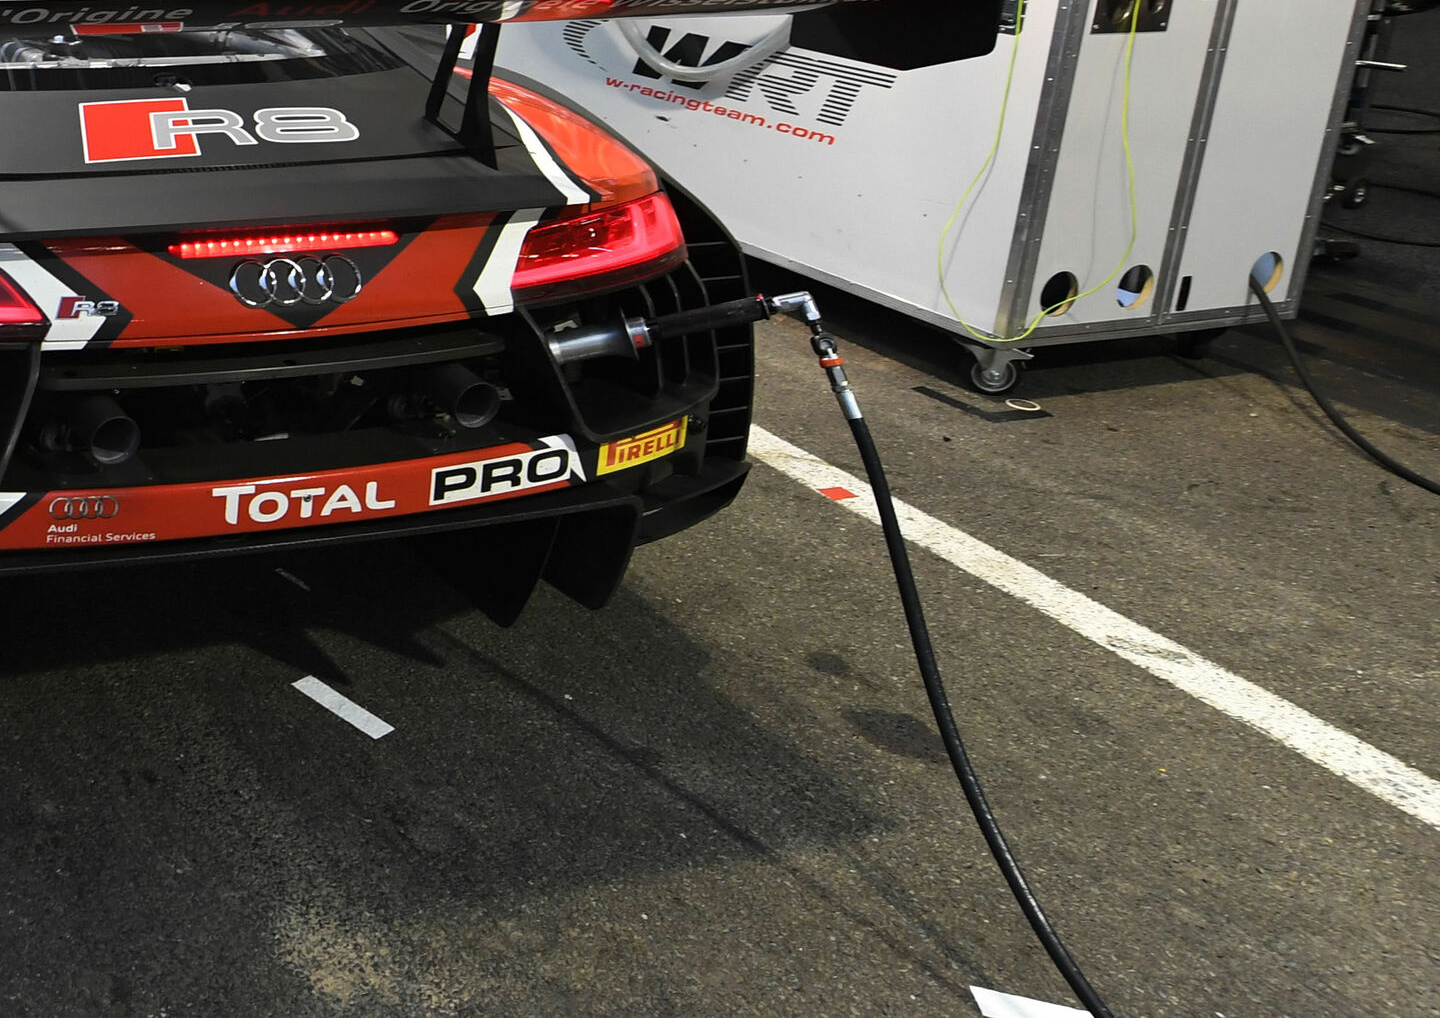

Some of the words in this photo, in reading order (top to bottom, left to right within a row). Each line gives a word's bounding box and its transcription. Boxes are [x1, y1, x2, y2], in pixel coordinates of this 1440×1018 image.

[148, 106, 361, 152] R8
[605, 76, 836, 146] w-racingteam.com
[70, 298, 120, 319] R8
[606, 421, 682, 467] PIRELLI
[433, 449, 570, 500] PRO
[211, 480, 396, 526] TOTAL
[46, 533, 102, 543] Financial
[105, 531, 156, 542] Services
[47, 524, 78, 533] Audi
